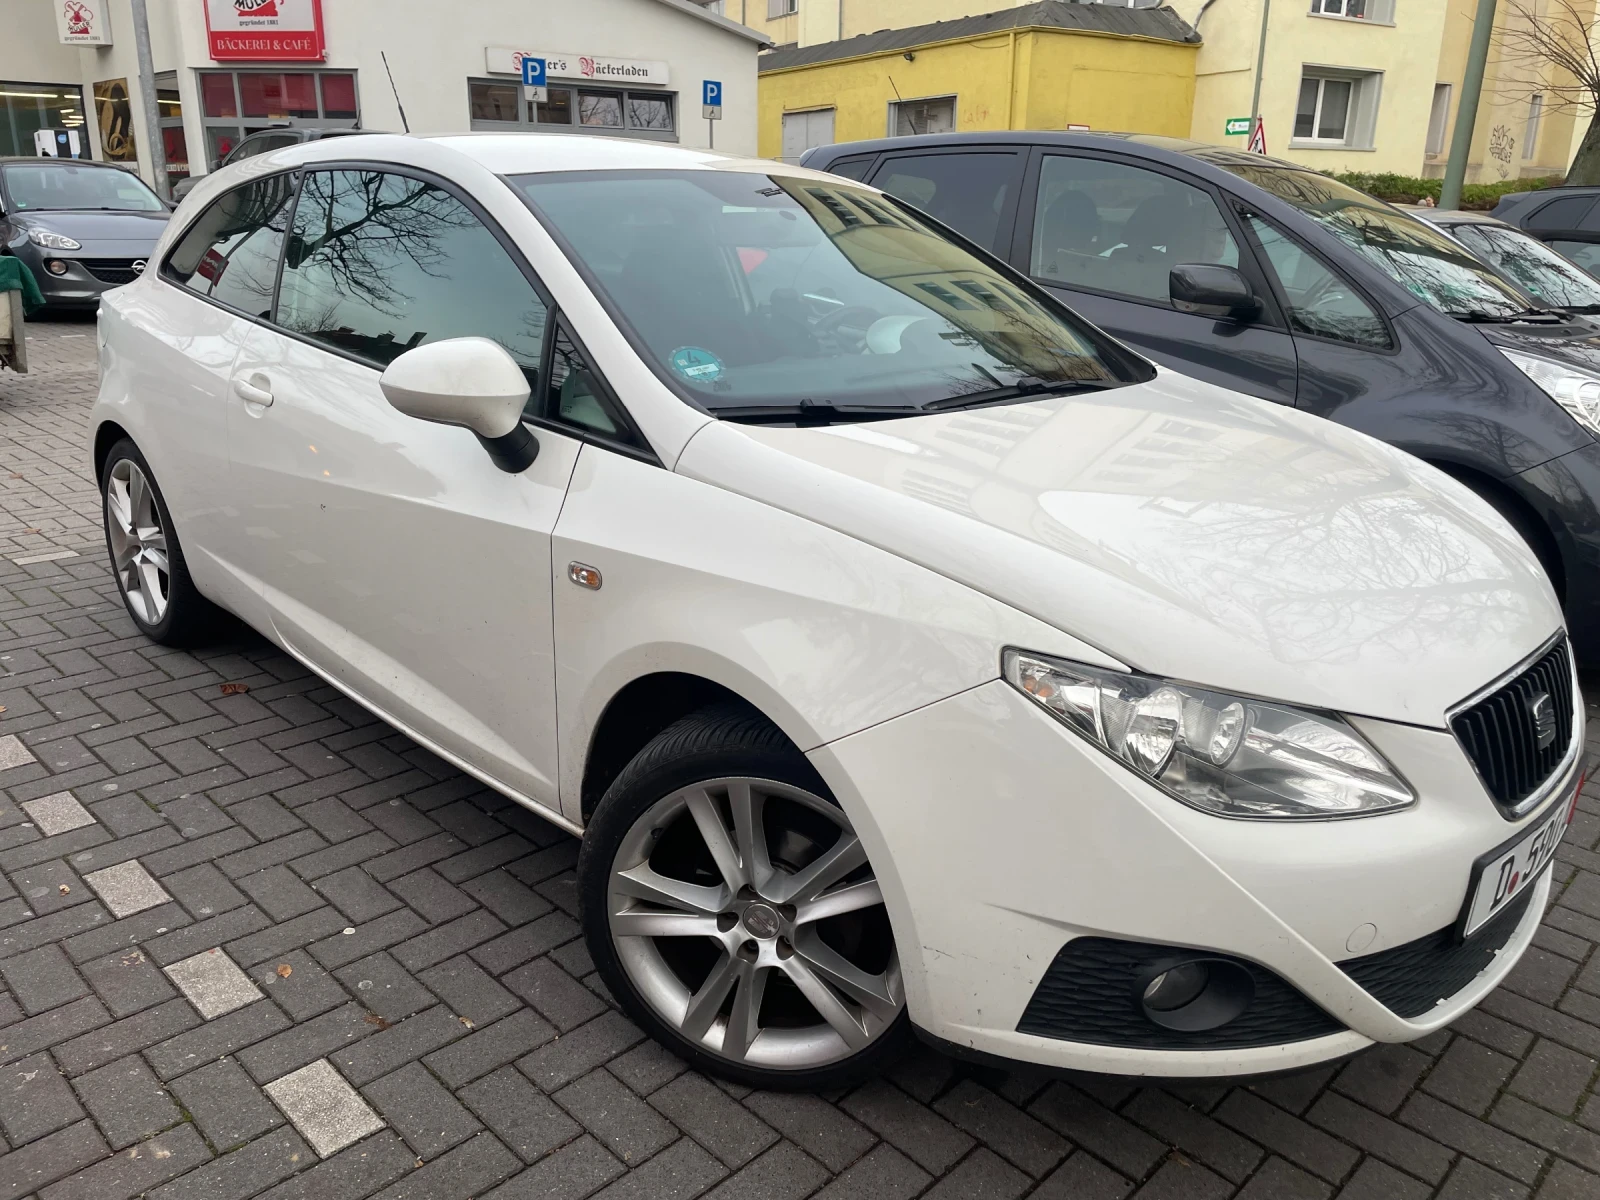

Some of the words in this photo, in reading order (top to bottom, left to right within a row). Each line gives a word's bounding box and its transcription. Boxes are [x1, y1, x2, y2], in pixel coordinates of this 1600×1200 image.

[217, 37, 270, 50] BÄCKEREI
[273, 40, 281, 50] &
[283, 37, 312, 50] CAFÉ
[527, 61, 541, 84] P
[579, 57, 649, 78] Bäckerladen
[707, 83, 718, 104] P
[1490, 854, 1515, 912] D
